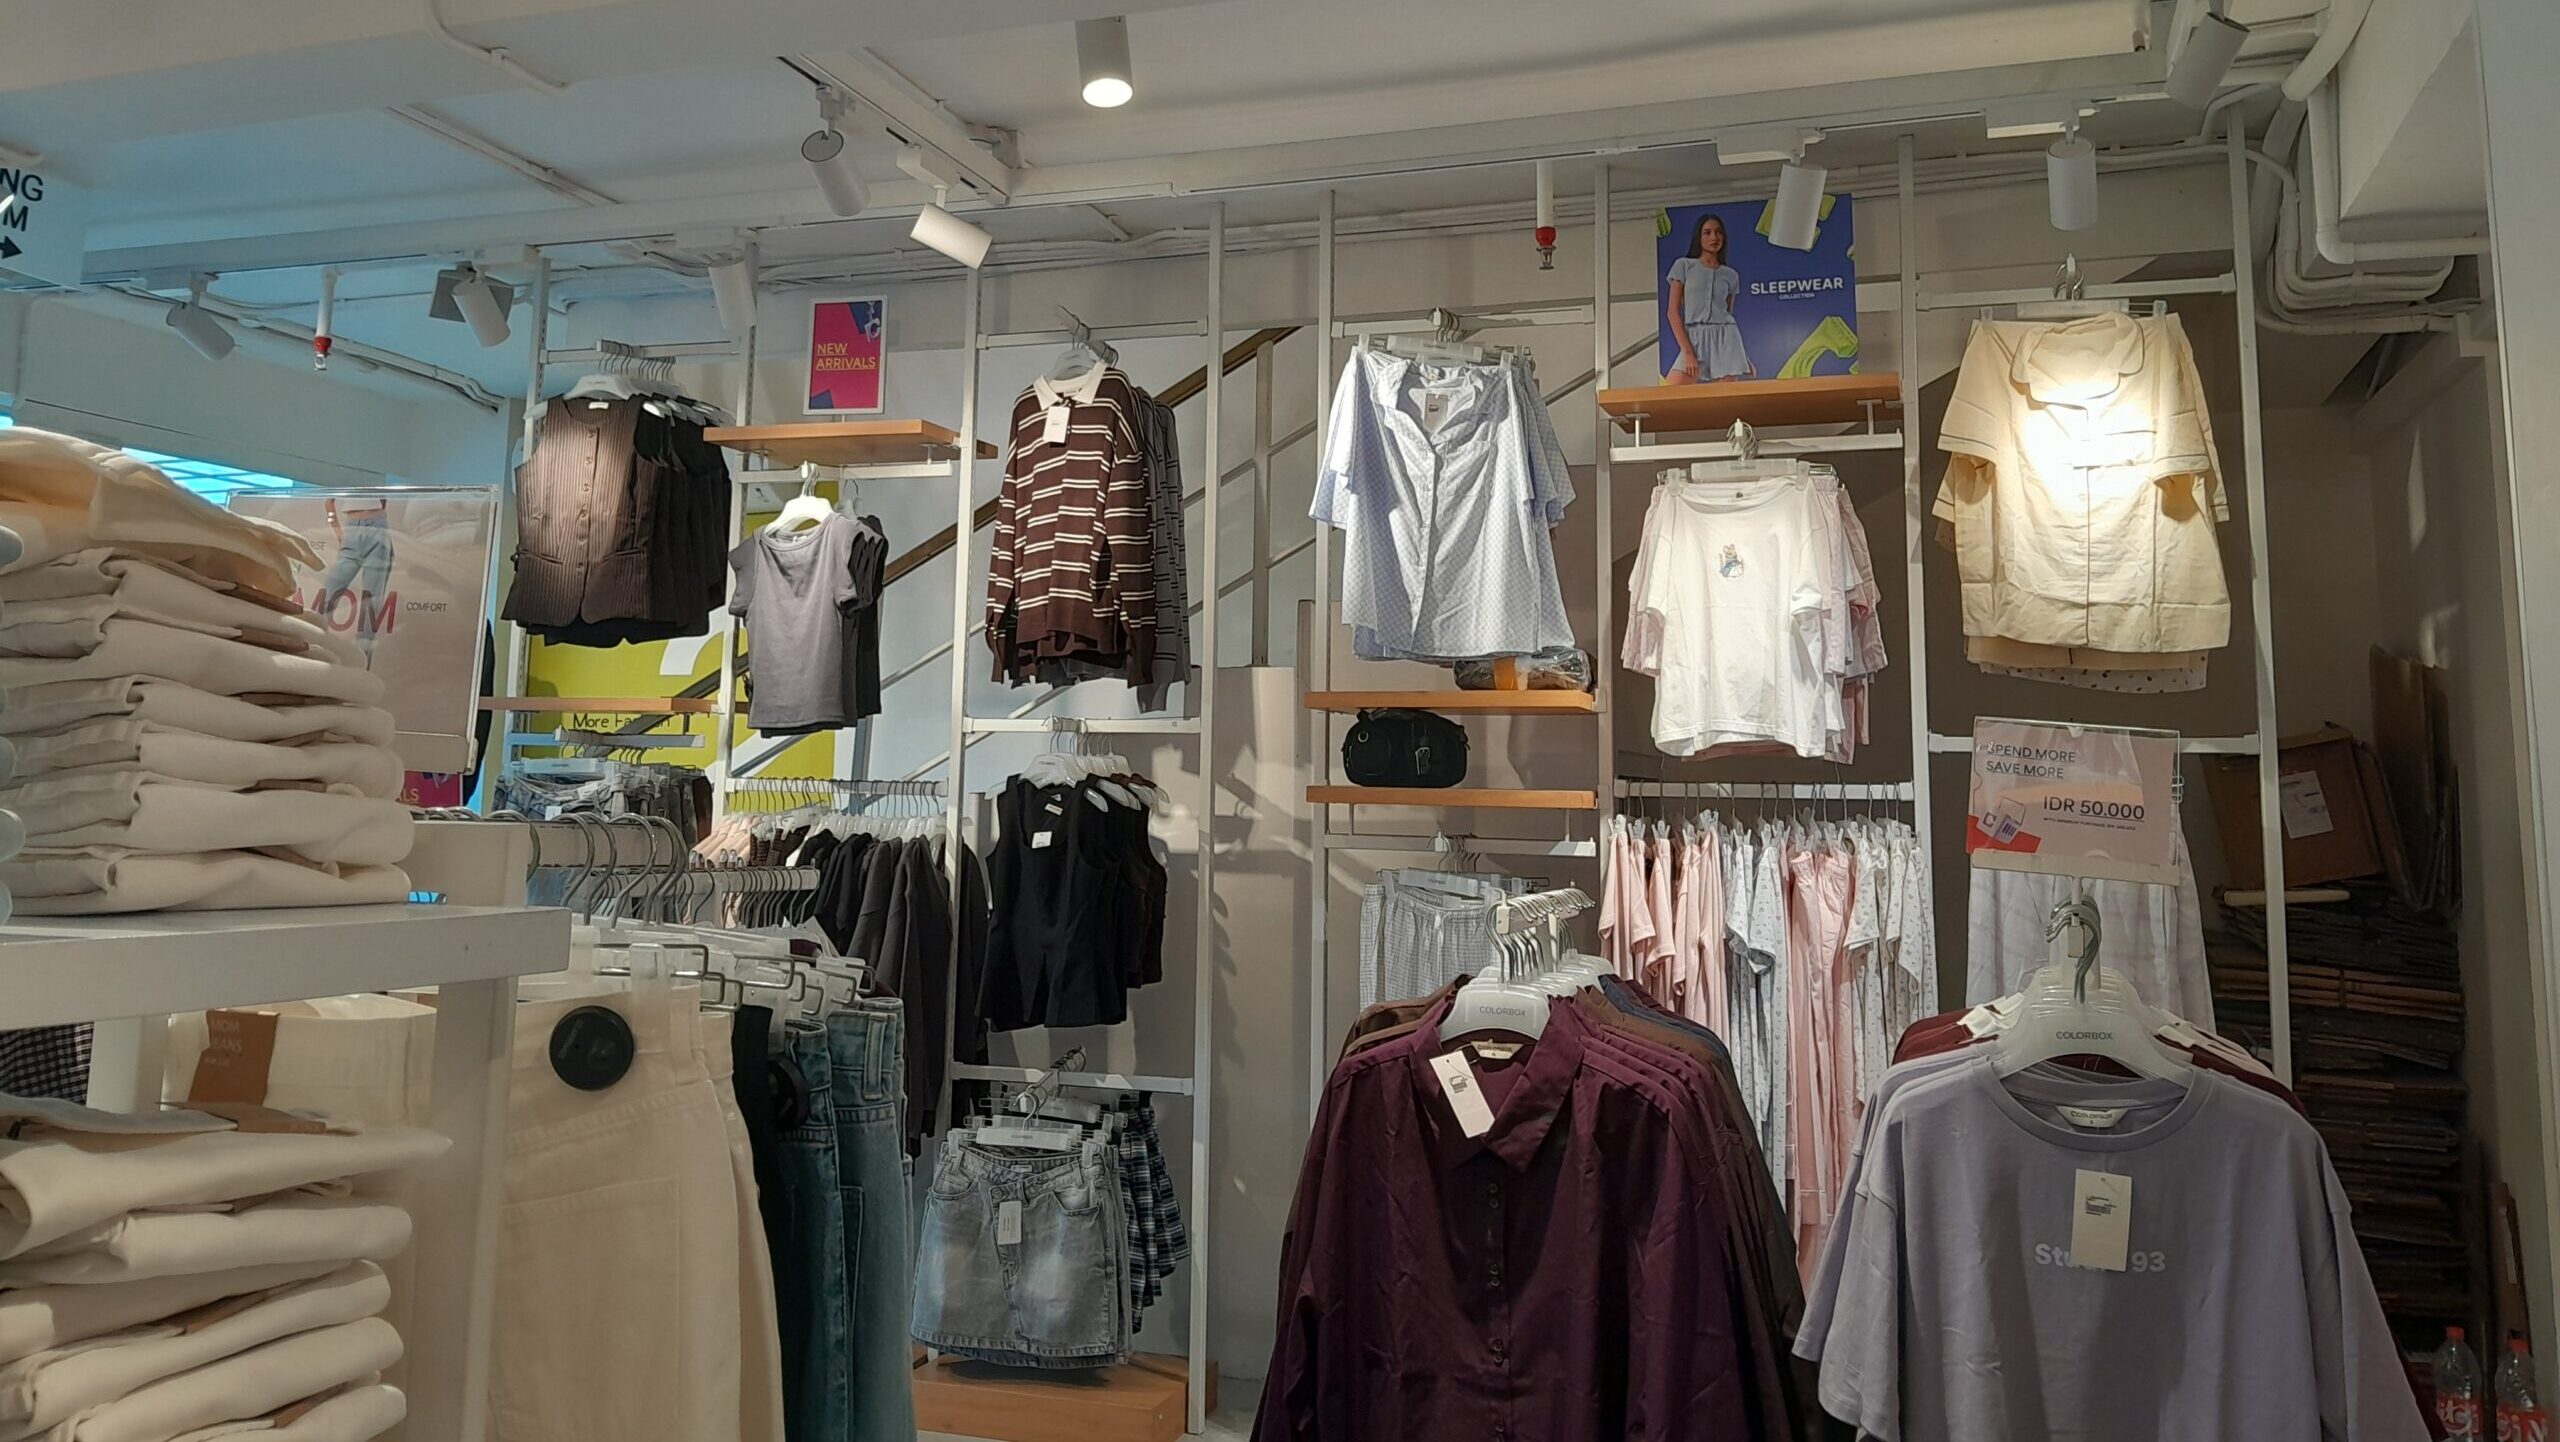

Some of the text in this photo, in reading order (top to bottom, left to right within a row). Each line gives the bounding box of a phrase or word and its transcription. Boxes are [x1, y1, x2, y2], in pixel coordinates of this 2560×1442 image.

[1750, 277, 1844, 295] SLEEPWEAR
[817, 343, 848, 354] NEW
[816, 356, 876, 369] ARRIVALS
[406, 601, 448, 612] COMFORT
[572, 711, 610, 728] More
[1987, 742, 2076, 762] SPEND MORE
[1986, 760, 2064, 779] SAVE MORE
[2043, 796, 2145, 820] IDR 50.000
[1479, 1006, 1527, 1017] COLORBOX
[2055, 1031, 2113, 1041] COLORBOX
[2131, 1251, 2166, 1272] 93
